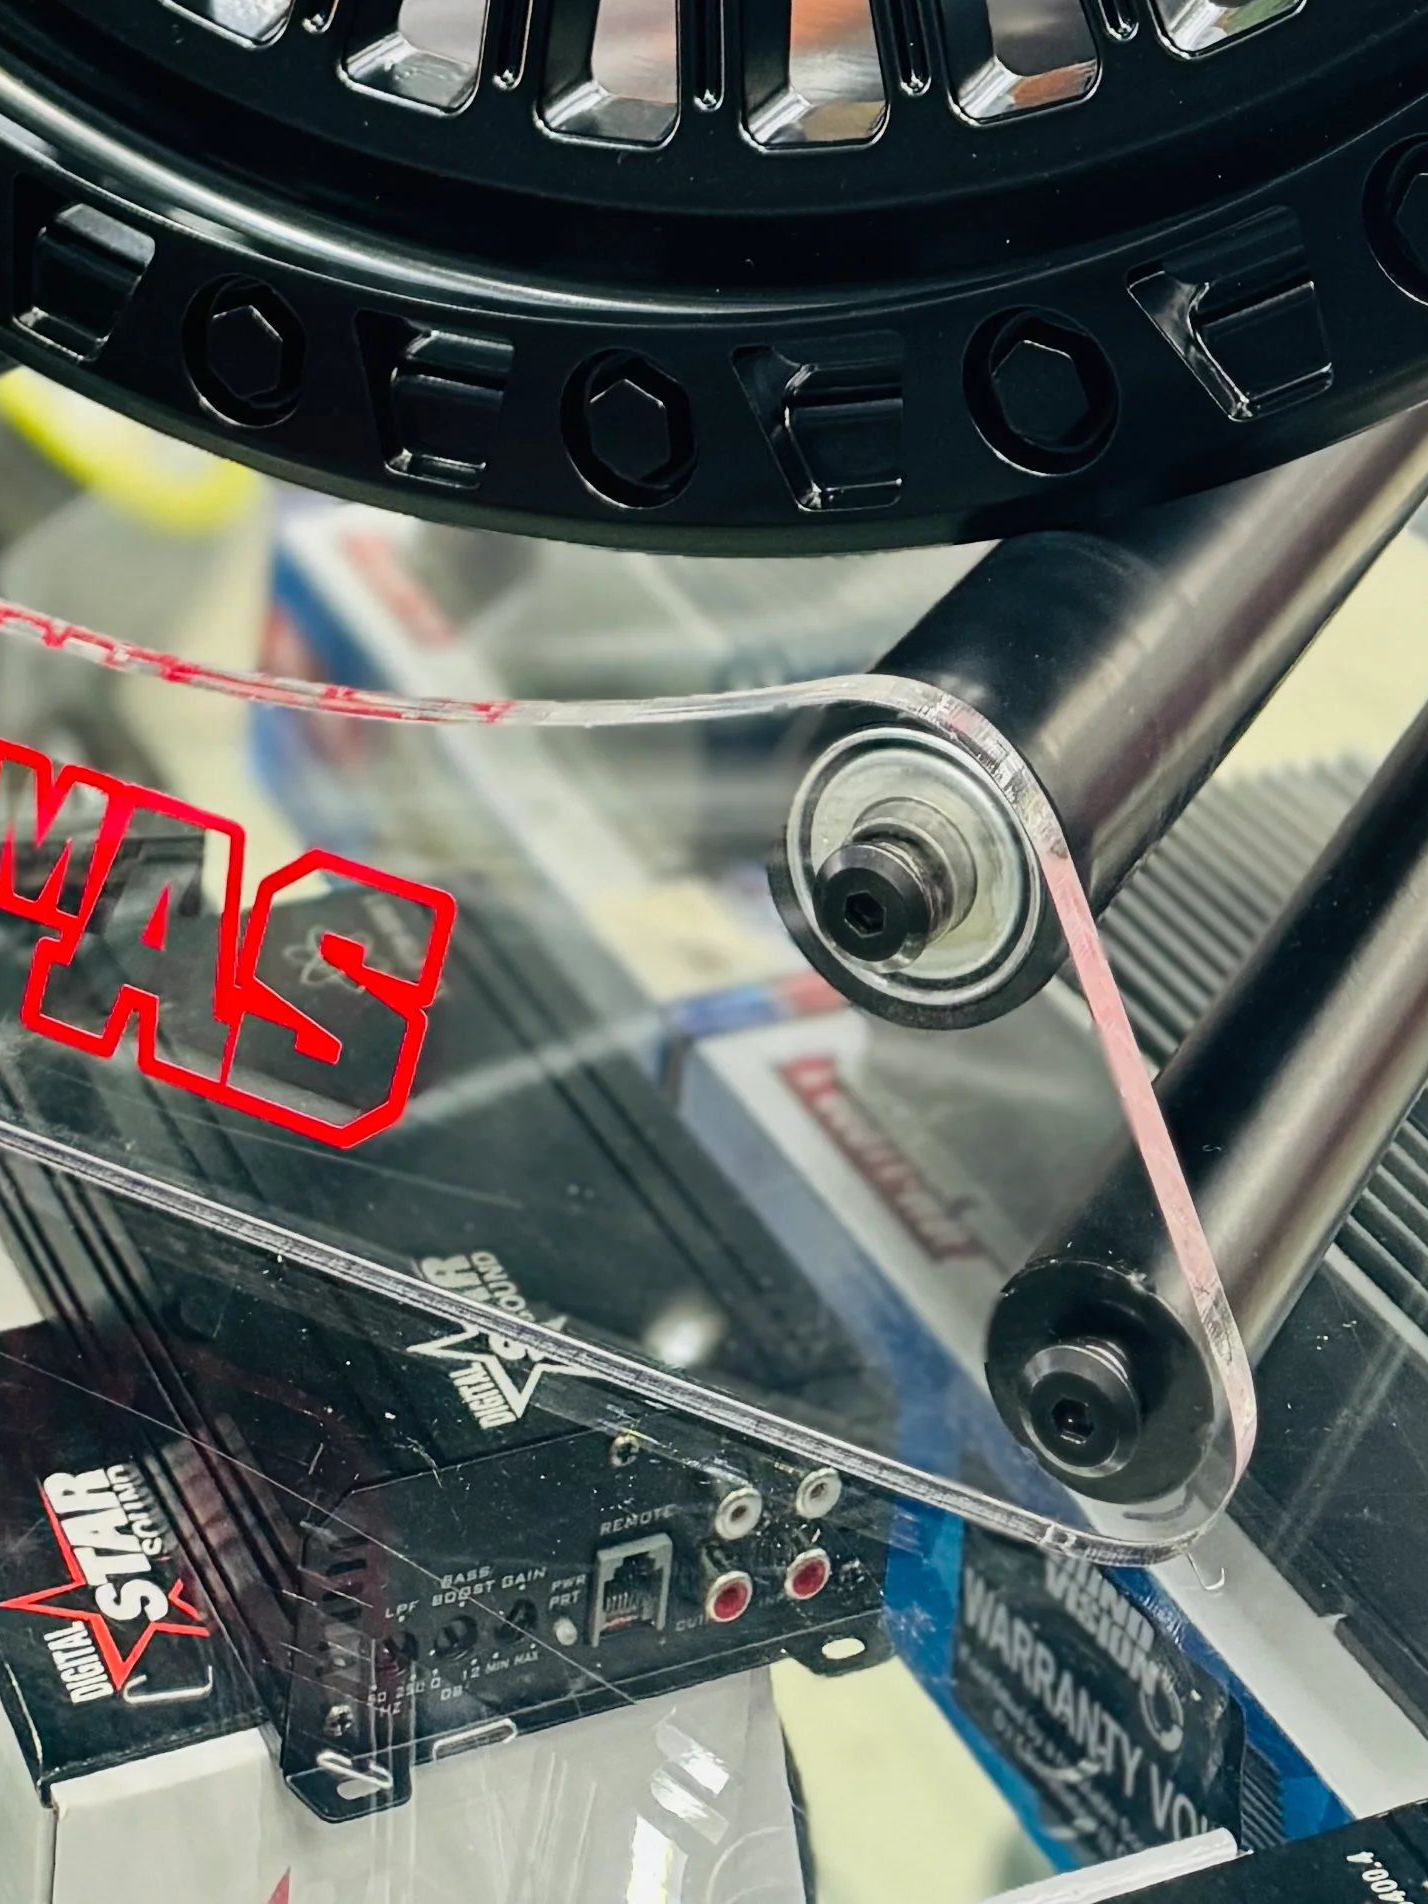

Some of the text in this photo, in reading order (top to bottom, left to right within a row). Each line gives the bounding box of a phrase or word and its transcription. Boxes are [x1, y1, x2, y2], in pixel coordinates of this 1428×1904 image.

[448, 1362, 517, 1430] DIGITAL
[106, 1464, 164, 1556] SOUND
[599, 1503, 676, 1536] REMOTE
[43, 1468, 169, 1622] STAR
[431, 1566, 547, 1607] BOOST GAIN
[441, 1565, 491, 1589] BASS
[551, 1573, 587, 1592] PWR
[384, 1599, 420, 1619] LPF
[548, 1590, 582, 1610] PRT
[43, 1620, 115, 1704] DIGITAL
[963, 1564, 1144, 1798] WARRANTY
